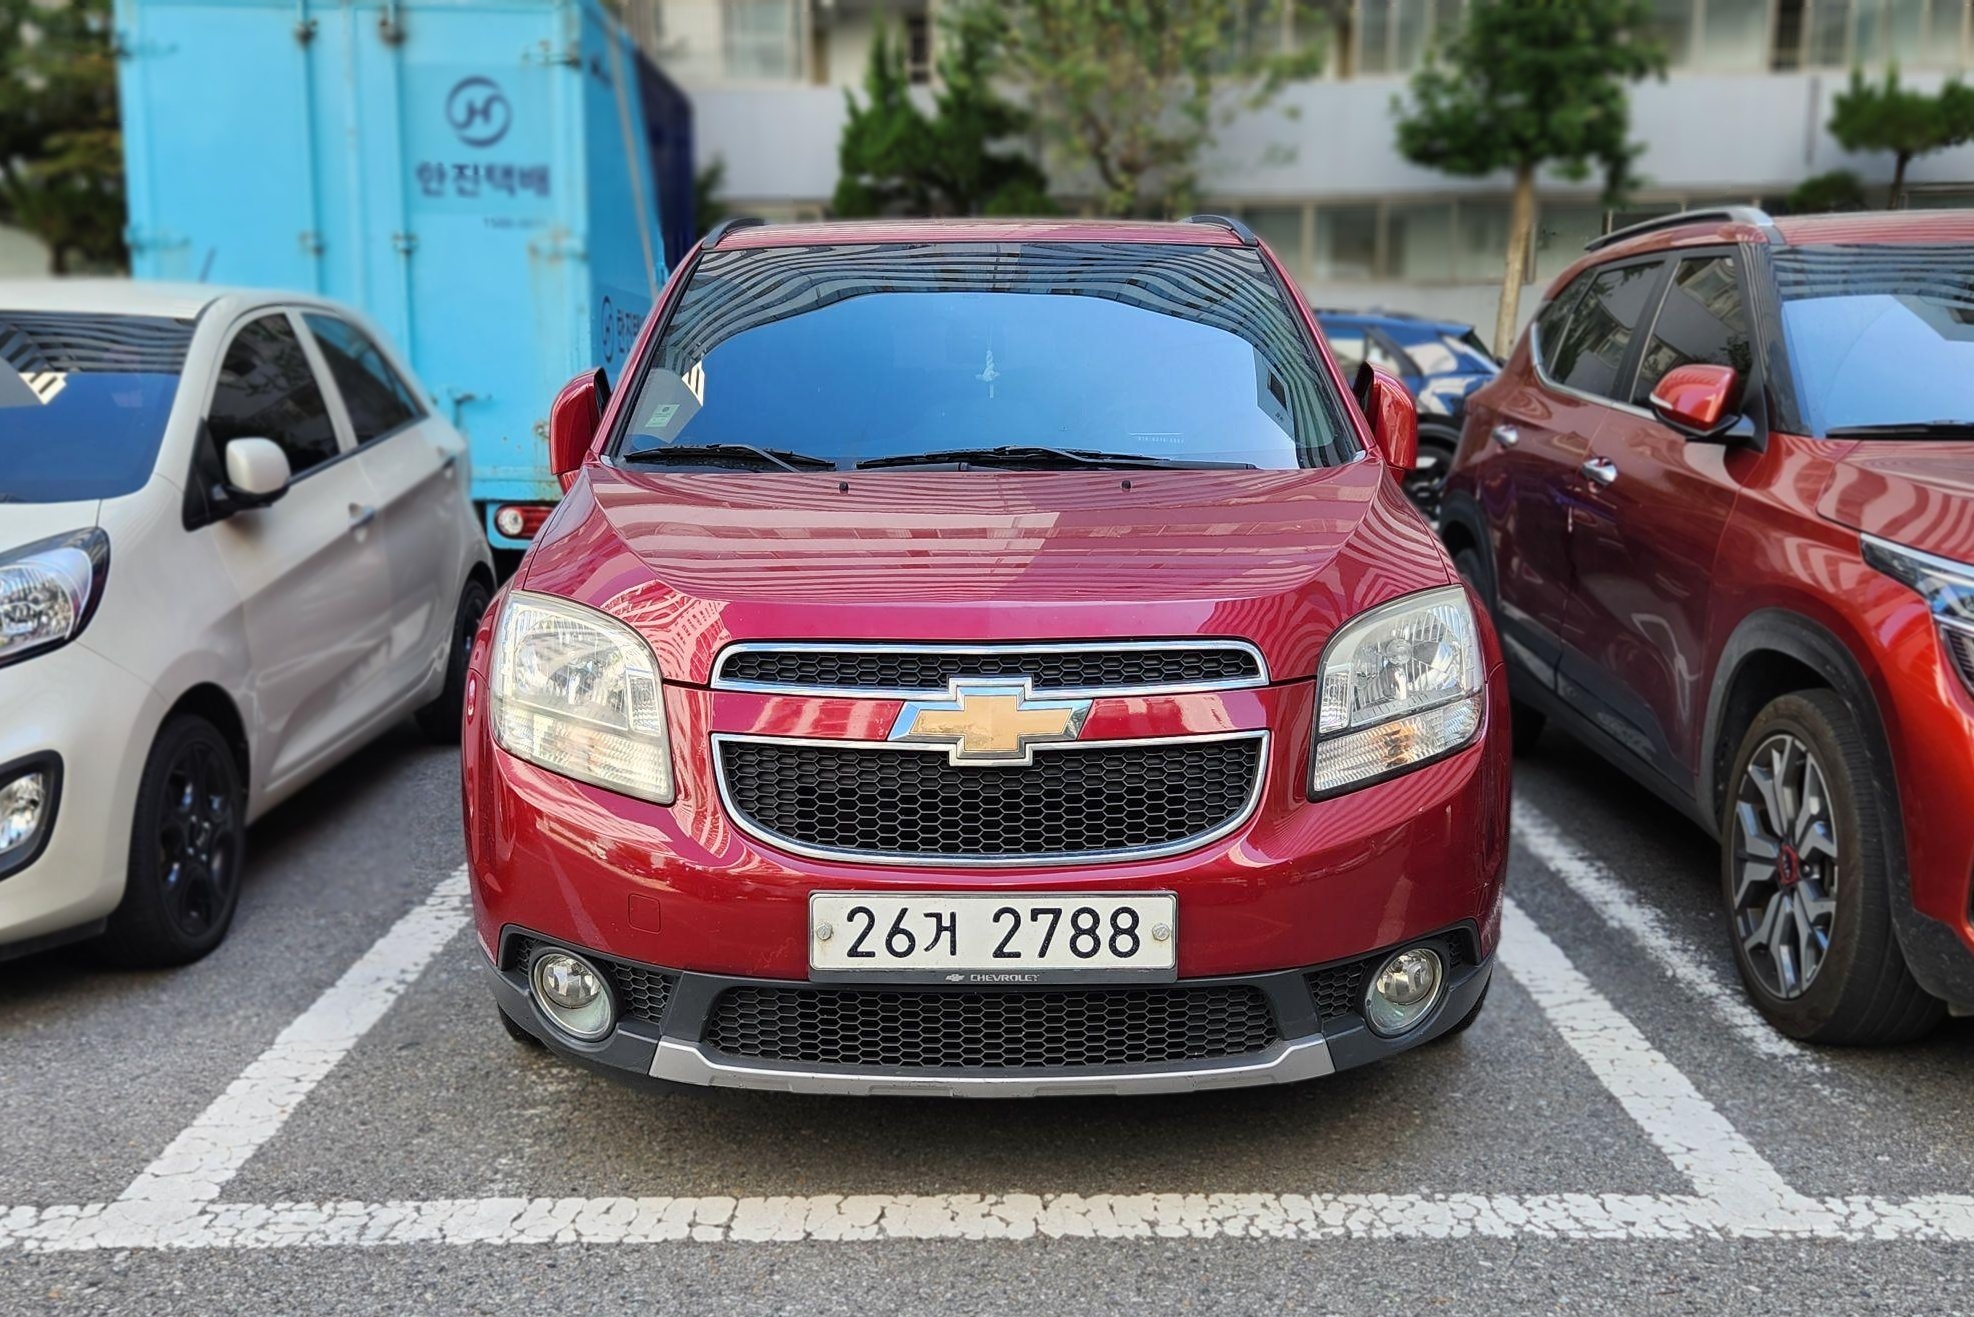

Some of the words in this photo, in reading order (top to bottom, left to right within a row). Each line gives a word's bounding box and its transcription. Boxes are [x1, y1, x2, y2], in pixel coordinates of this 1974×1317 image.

[846, 906, 957, 958] 26거
[992, 906, 1140, 958] 2788
[969, 973, 1040, 982] CHEVROLET
